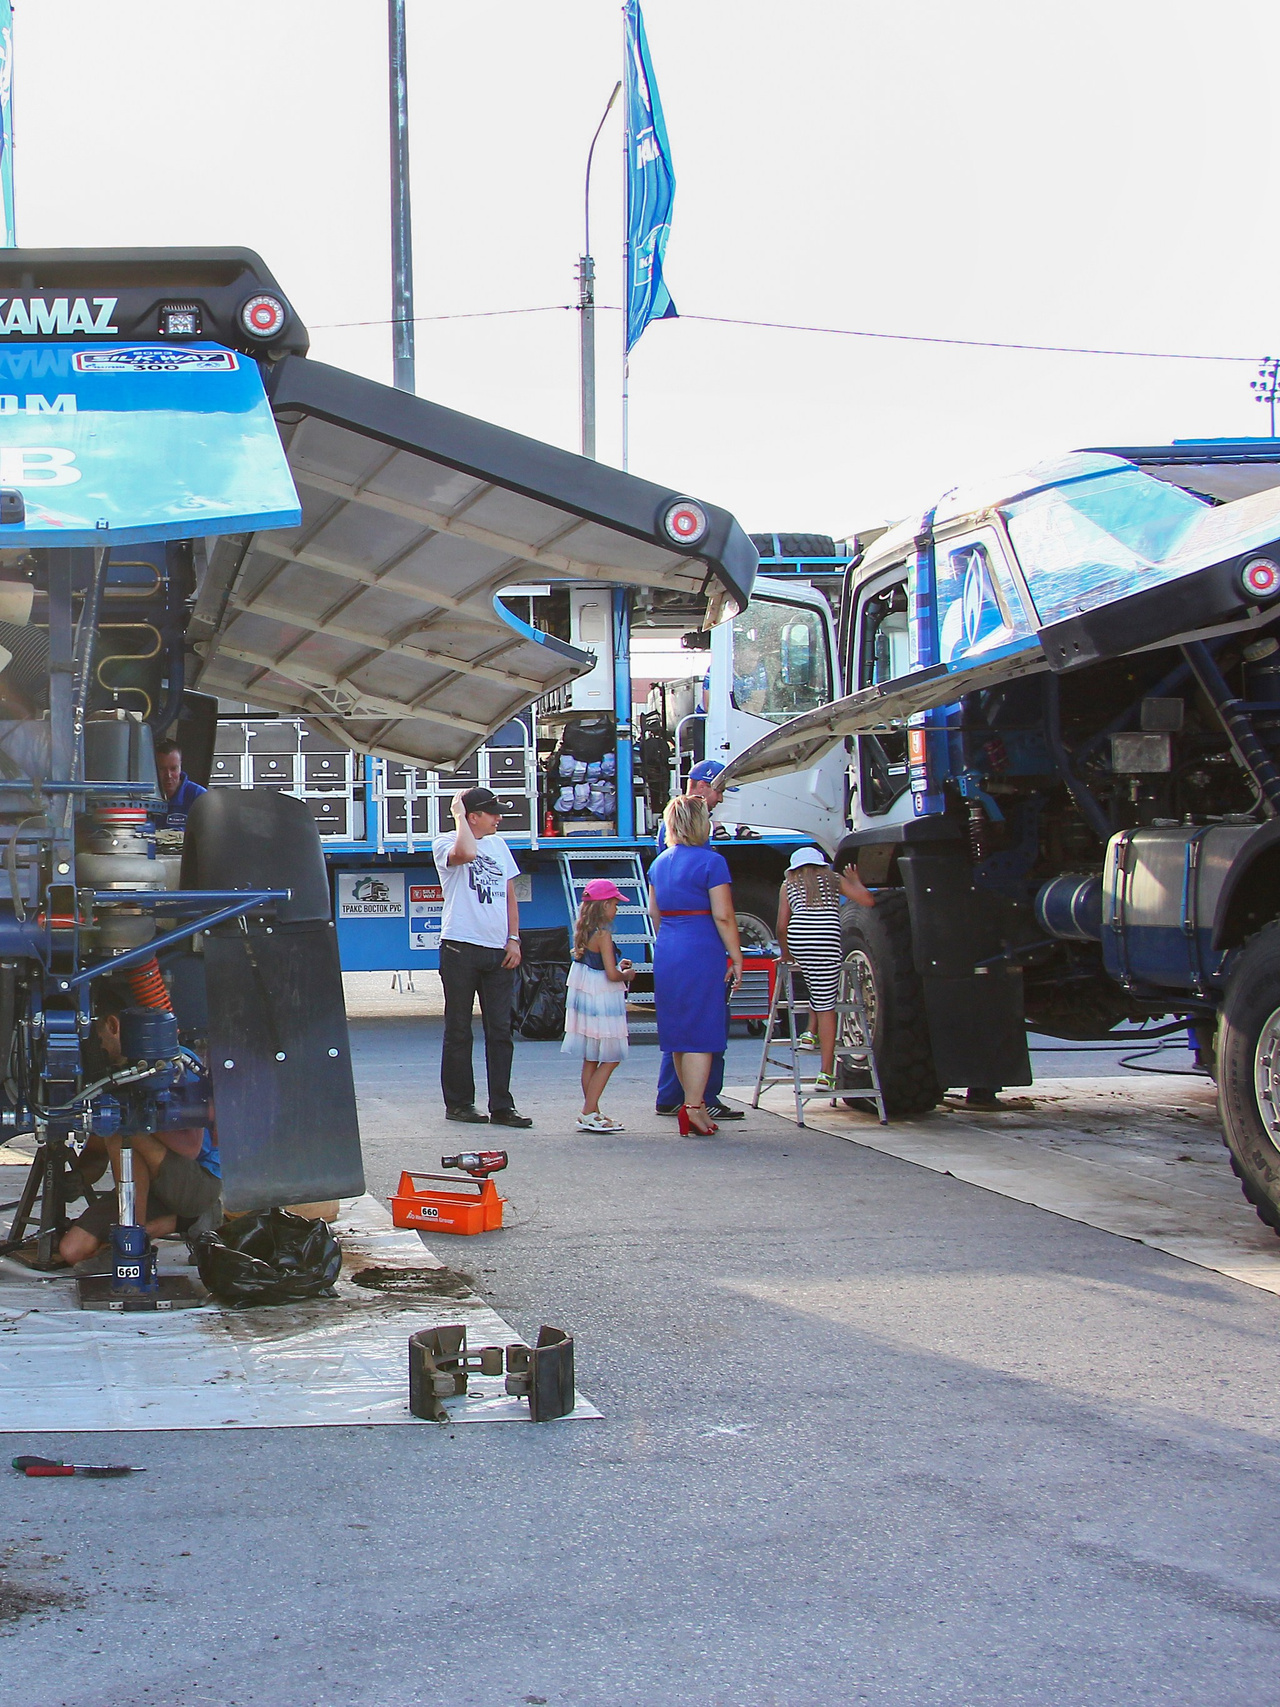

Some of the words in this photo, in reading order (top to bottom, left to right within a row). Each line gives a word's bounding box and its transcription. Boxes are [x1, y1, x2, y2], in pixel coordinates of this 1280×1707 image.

[342, 904, 363, 913] ТРАКС
[363, 904, 387, 913] ВОСТОК
[389, 904, 402, 913] РУС
[422, 1207, 438, 1216] 660
[118, 1267, 139, 1277] 660
